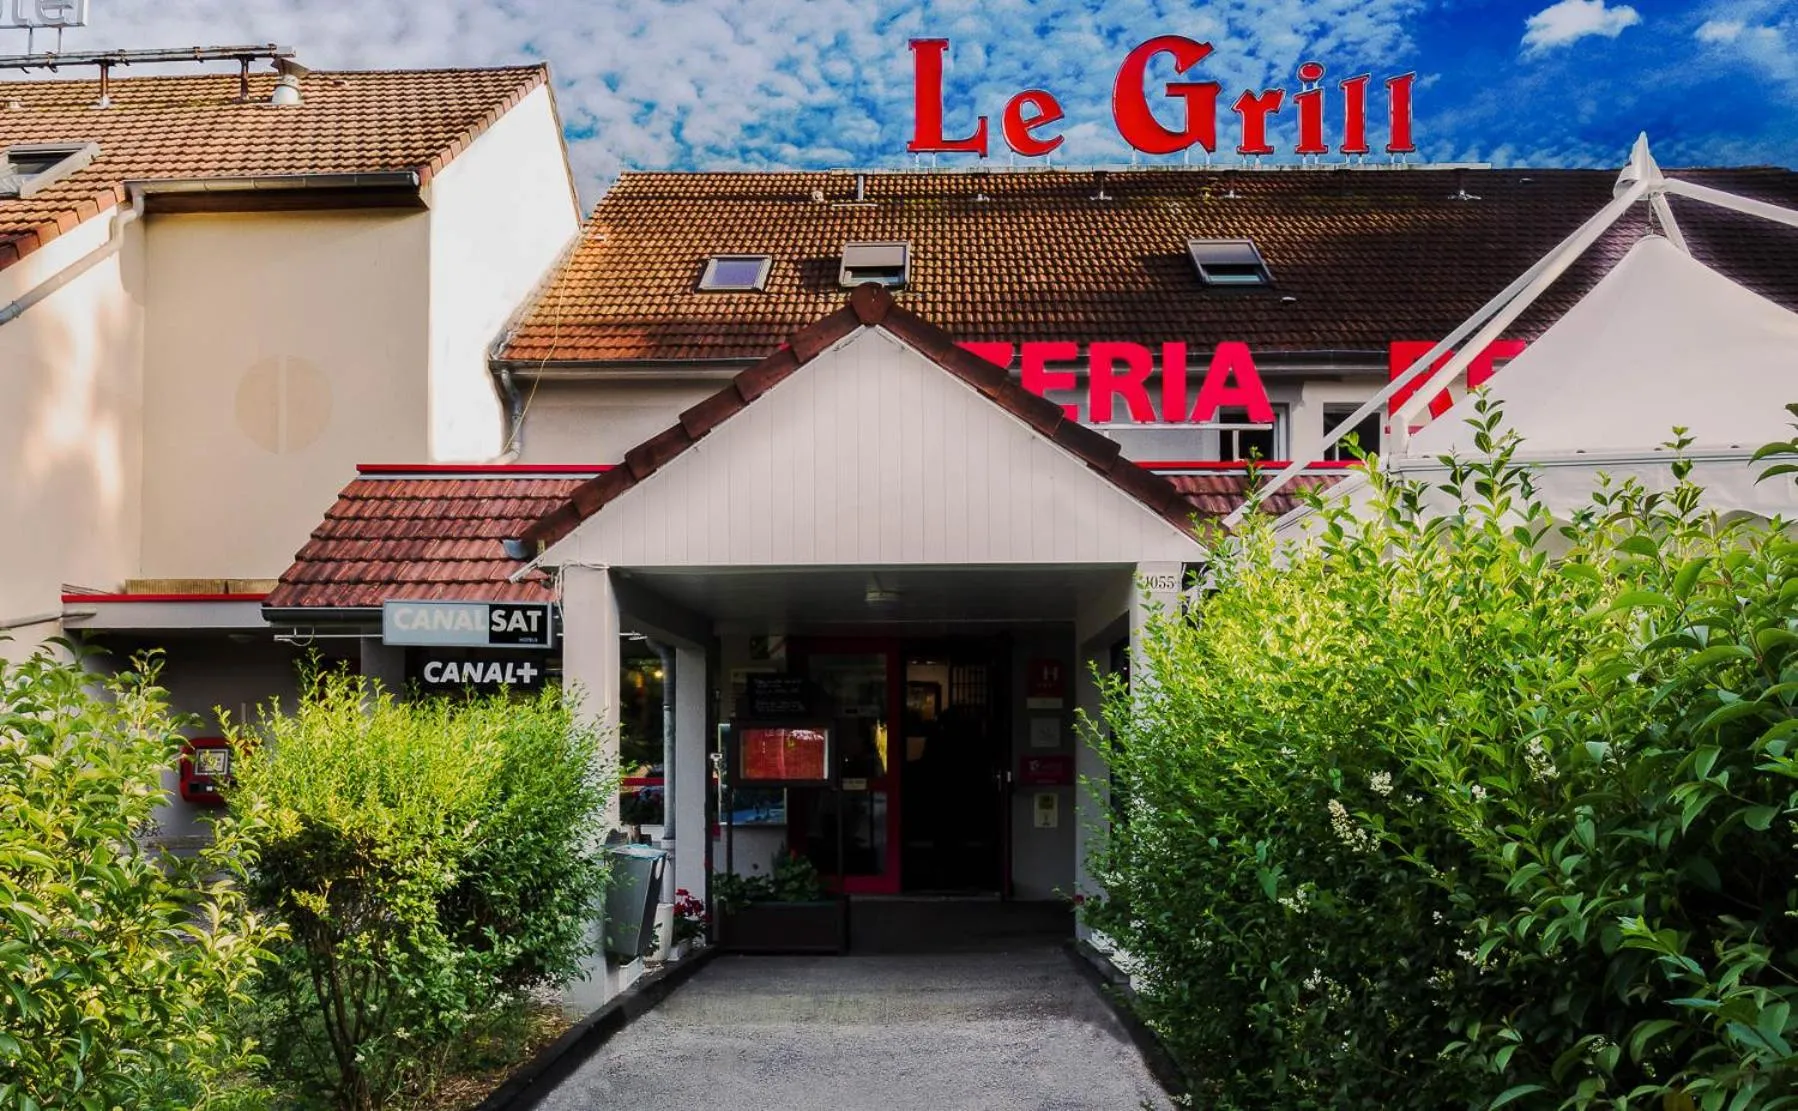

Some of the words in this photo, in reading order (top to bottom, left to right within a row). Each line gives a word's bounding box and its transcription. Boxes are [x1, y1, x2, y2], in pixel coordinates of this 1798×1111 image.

[907, 38, 1065, 156] Le
[1113, 35, 1415, 155] Grill
[423, 661, 538, 683] CANAL+
